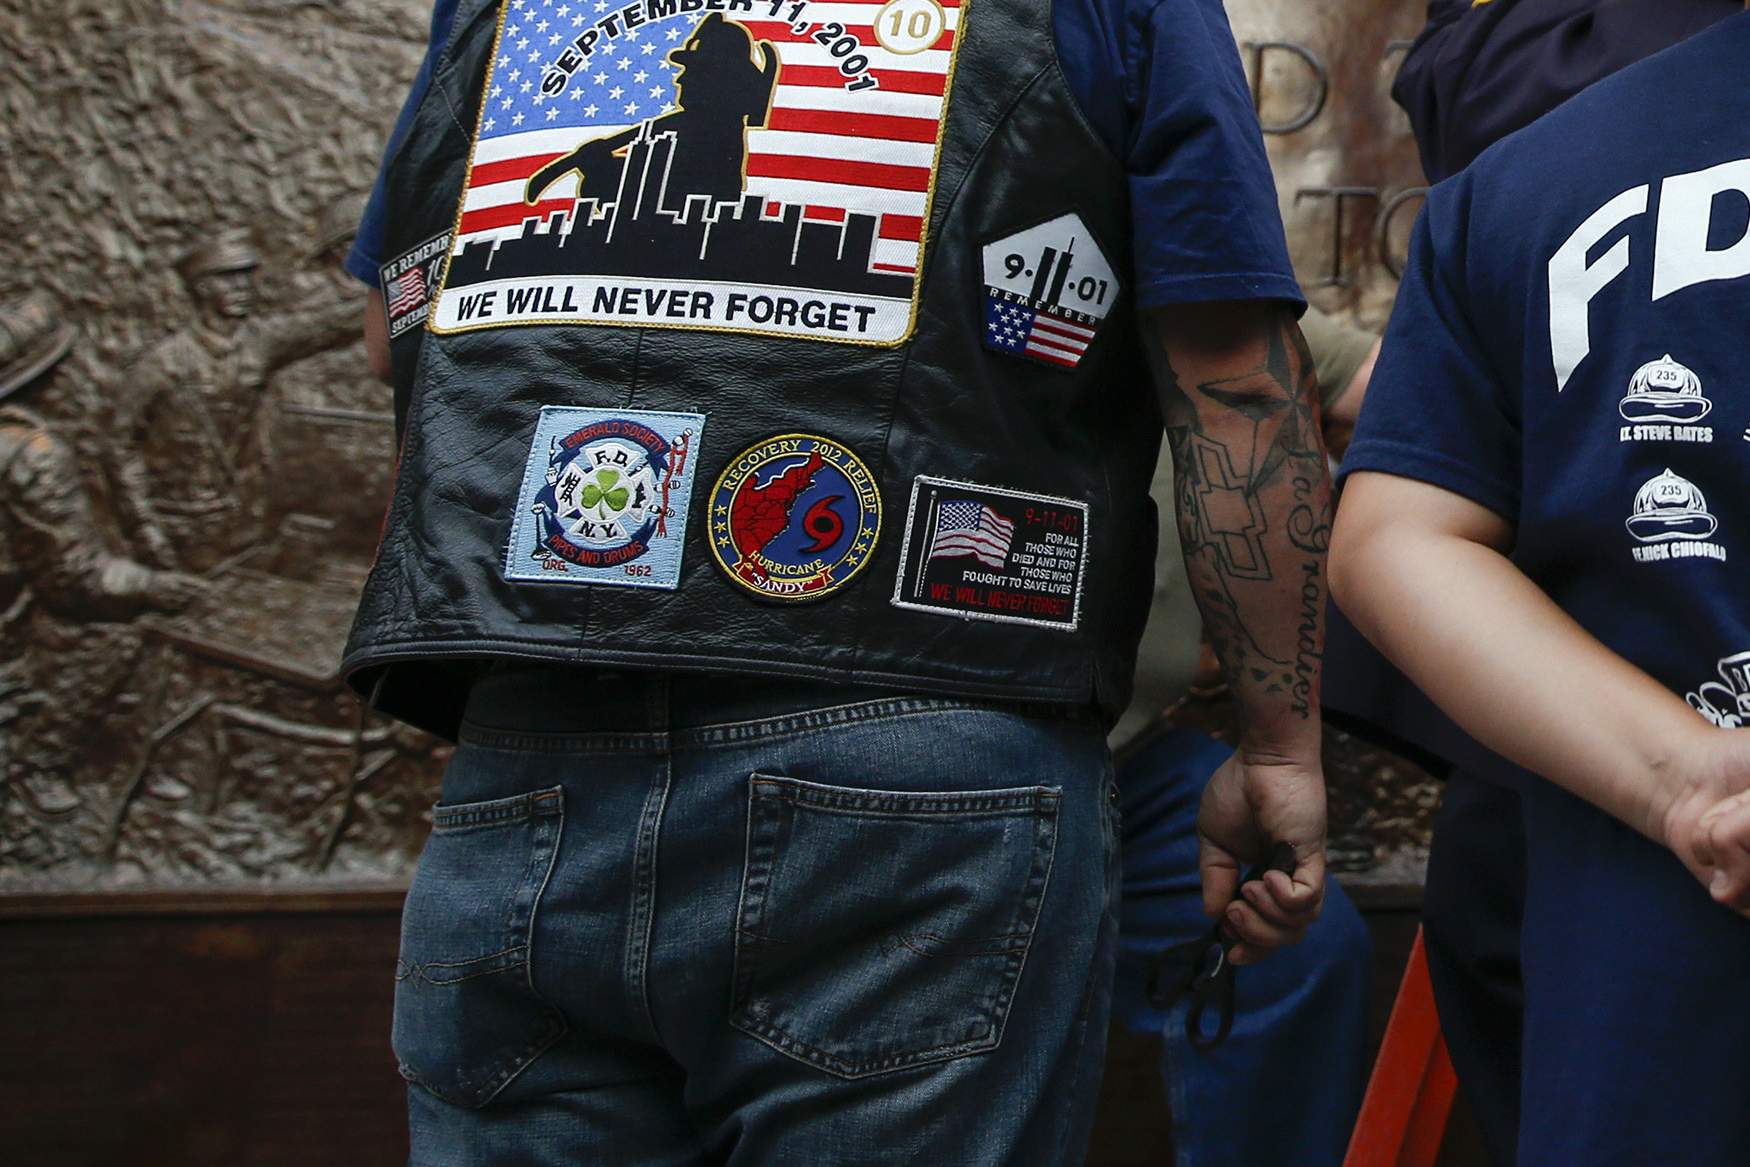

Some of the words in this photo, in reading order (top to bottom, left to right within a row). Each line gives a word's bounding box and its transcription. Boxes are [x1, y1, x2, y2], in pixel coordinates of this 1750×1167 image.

[889, 10, 930, 38] 10
[815, 22, 879, 93] 2001
[399, 233, 452, 275] REMEMB
[457, 291, 496, 321] WE
[506, 286, 578, 316] WILL
[592, 286, 714, 319] NEVER
[726, 294, 876, 332] FORGET
[989, 287, 1096, 325] REMEMBER
[1656, 370, 1677, 381] 235
[565, 422, 620, 448] EMERALD
[623, 423, 667, 452] SOCIETY
[1633, 425, 1672, 441] STEVE
[1673, 426, 1713, 443] BATES
[723, 440, 801, 492] RECOVERY
[811, 441, 842, 461] 2012
[843, 460, 877, 514] RELIEF
[1661, 485, 1682, 496] 235
[1025, 508, 1079, 531] 9-11-01
[547, 534, 575, 557] PIPES
[577, 550, 601, 564] AND
[604, 541, 644, 563] DRUMS
[1025, 543, 1055, 555] THOSE
[1055, 546, 1077, 559] WHO
[1045, 532, 1062, 545] FOR
[1063, 535, 1080, 546] ALL
[542, 559, 568, 572] ORG.
[624, 565, 651, 577] 1962
[748, 550, 825, 575] HURRICANE
[1012, 553, 1034, 565] DIED
[1036, 557, 1056, 568] AND
[1058, 559, 1076, 571] FOR
[1020, 566, 1051, 579] THOSE
[1051, 570, 1072, 582] WHO
[963, 570, 1007, 585] FOUGHT
[1008, 577, 1021, 588] TO
[1023, 579, 1047, 592] SAVE
[1047, 581, 1072, 594] LIVES
[931, 583, 952, 601] WE
[955, 586, 985, 605] WILL
[987, 591, 1026, 610] NEVER
[1027, 596, 1070, 615] FORGET
